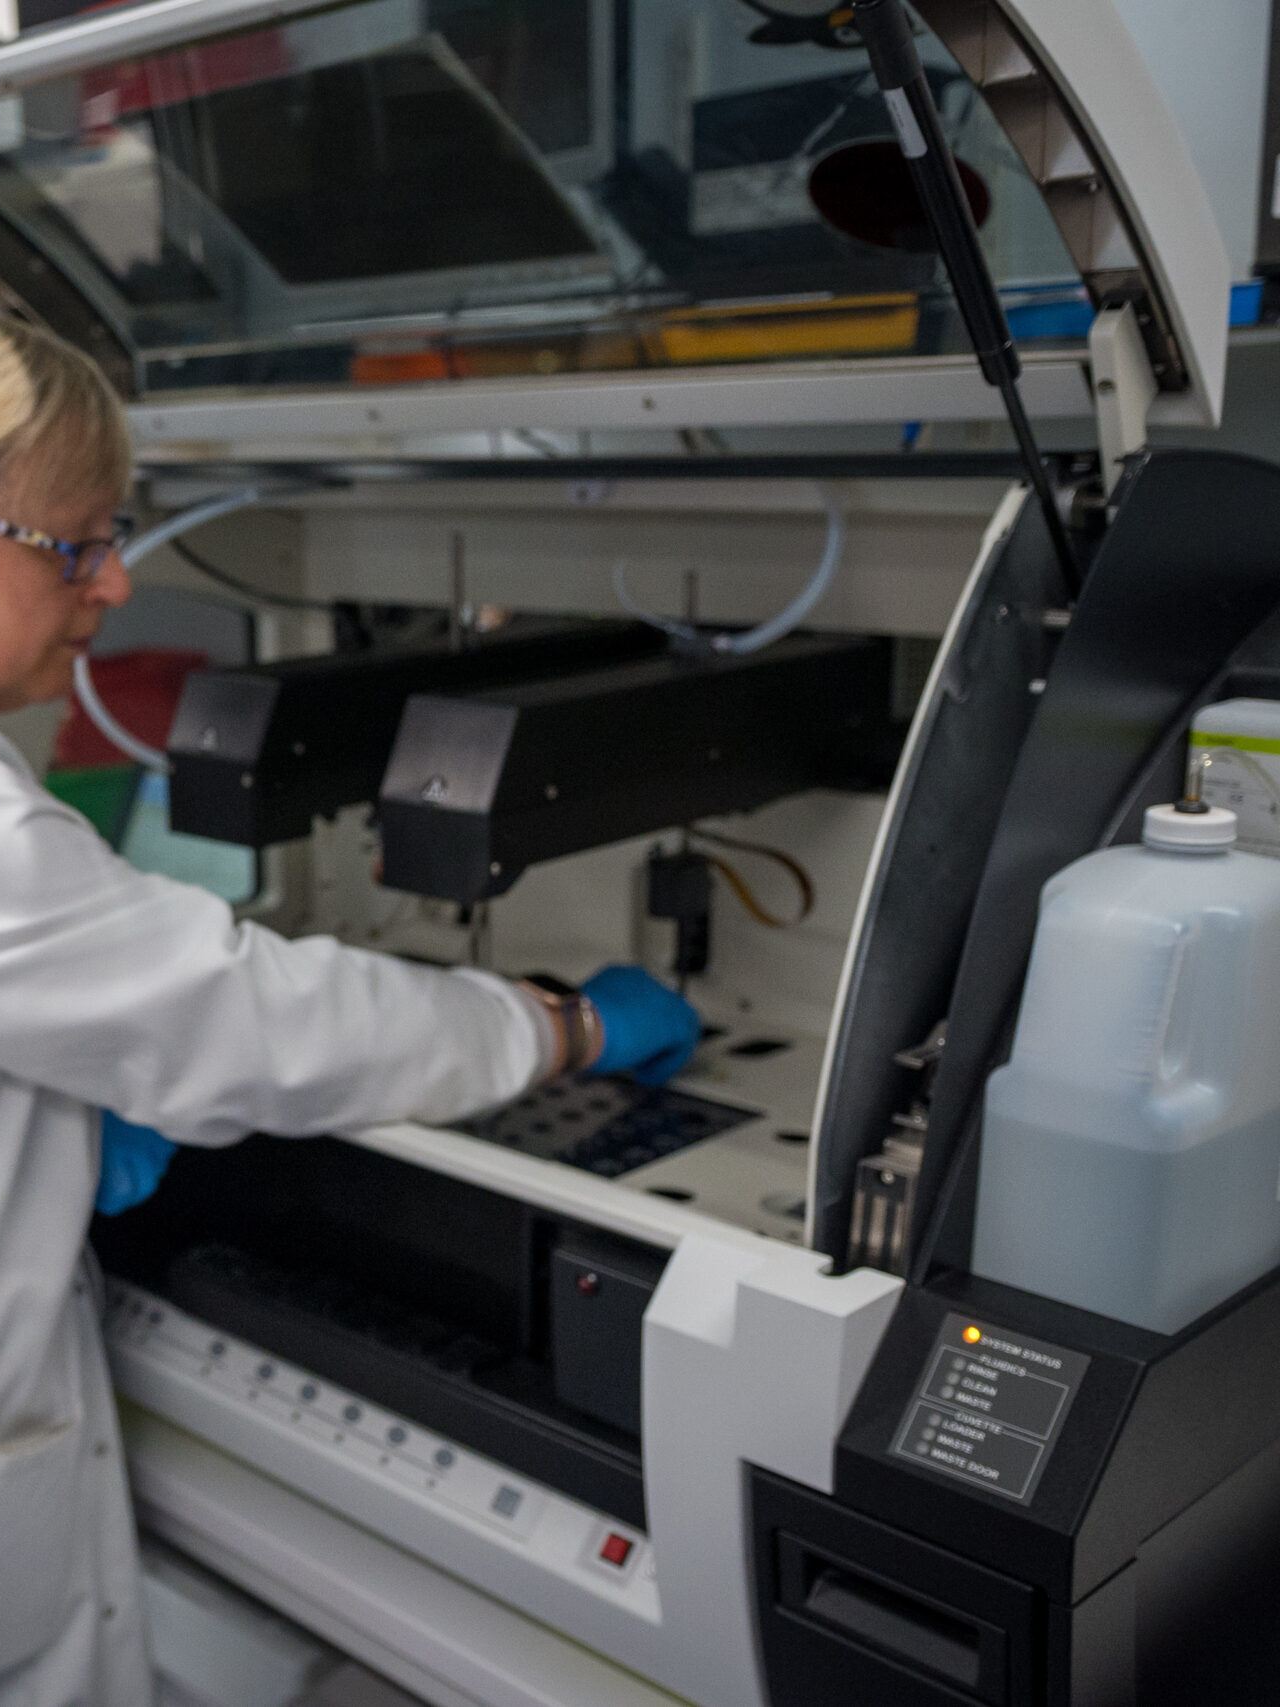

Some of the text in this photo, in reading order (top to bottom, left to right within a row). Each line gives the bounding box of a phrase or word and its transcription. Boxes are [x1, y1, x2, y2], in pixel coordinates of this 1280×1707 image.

[980, 1336, 1063, 1369] SYSTEM STATUS
[966, 1364, 999, 1381] RINSE
[979, 1355, 1026, 1376] FLUIDICS
[961, 1379, 997, 1397] CLEAN
[955, 1392, 992, 1410] WASTE
[942, 1420, 986, 1441] LOADER
[954, 1411, 1002, 1434] CUVETTE
[937, 1434, 974, 1454] WASTE
[931, 1448, 1000, 1480] WASTE DOOR
